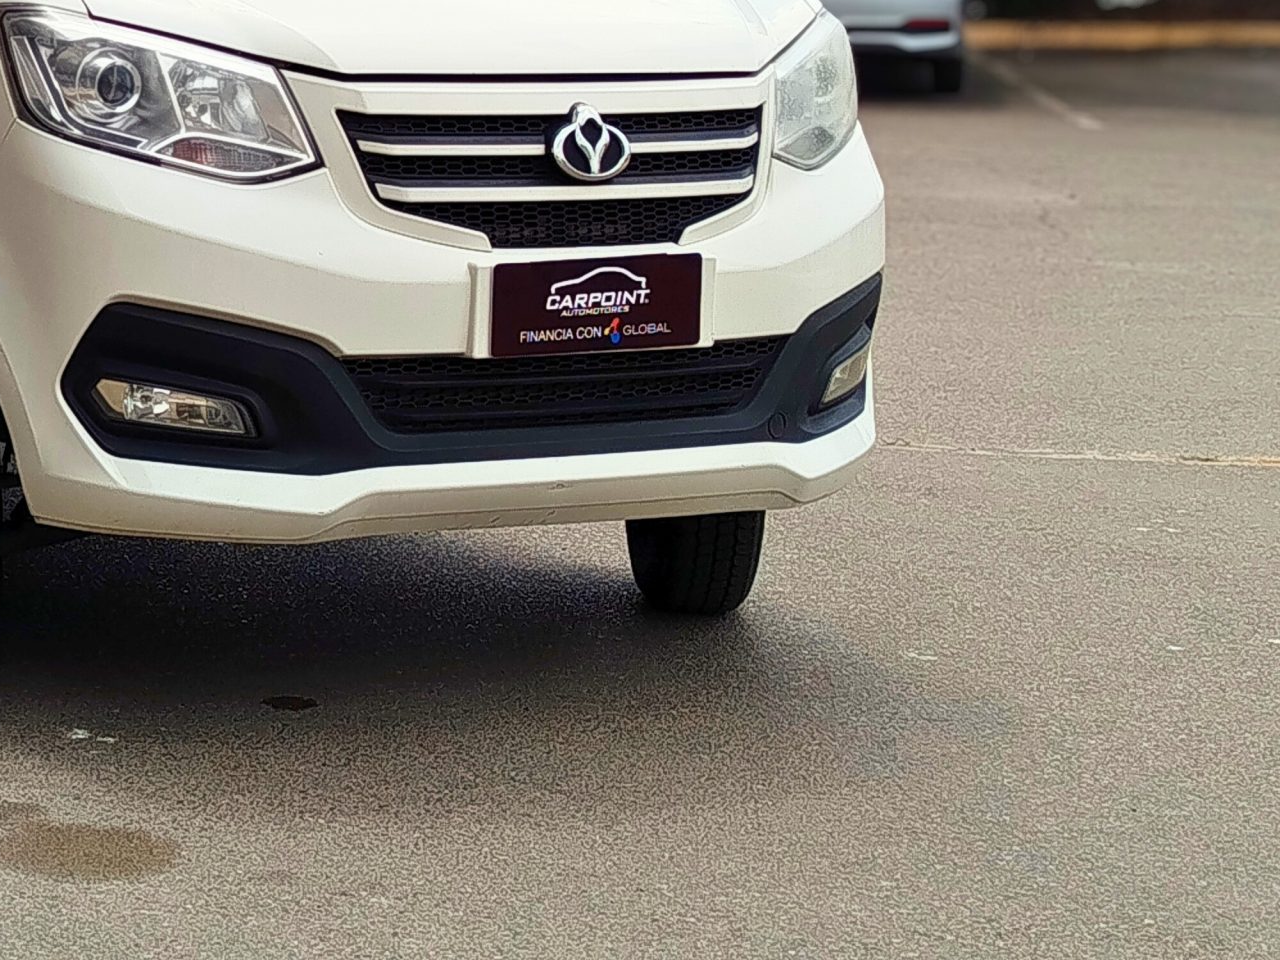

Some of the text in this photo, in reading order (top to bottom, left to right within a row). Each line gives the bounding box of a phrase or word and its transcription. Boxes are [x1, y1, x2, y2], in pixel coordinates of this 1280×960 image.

[546, 289, 650, 310] CARPOINT
[560, 305, 629, 317] AUTOMOTORES
[520, 323, 671, 343] FINANCIA CON GLOBAL
